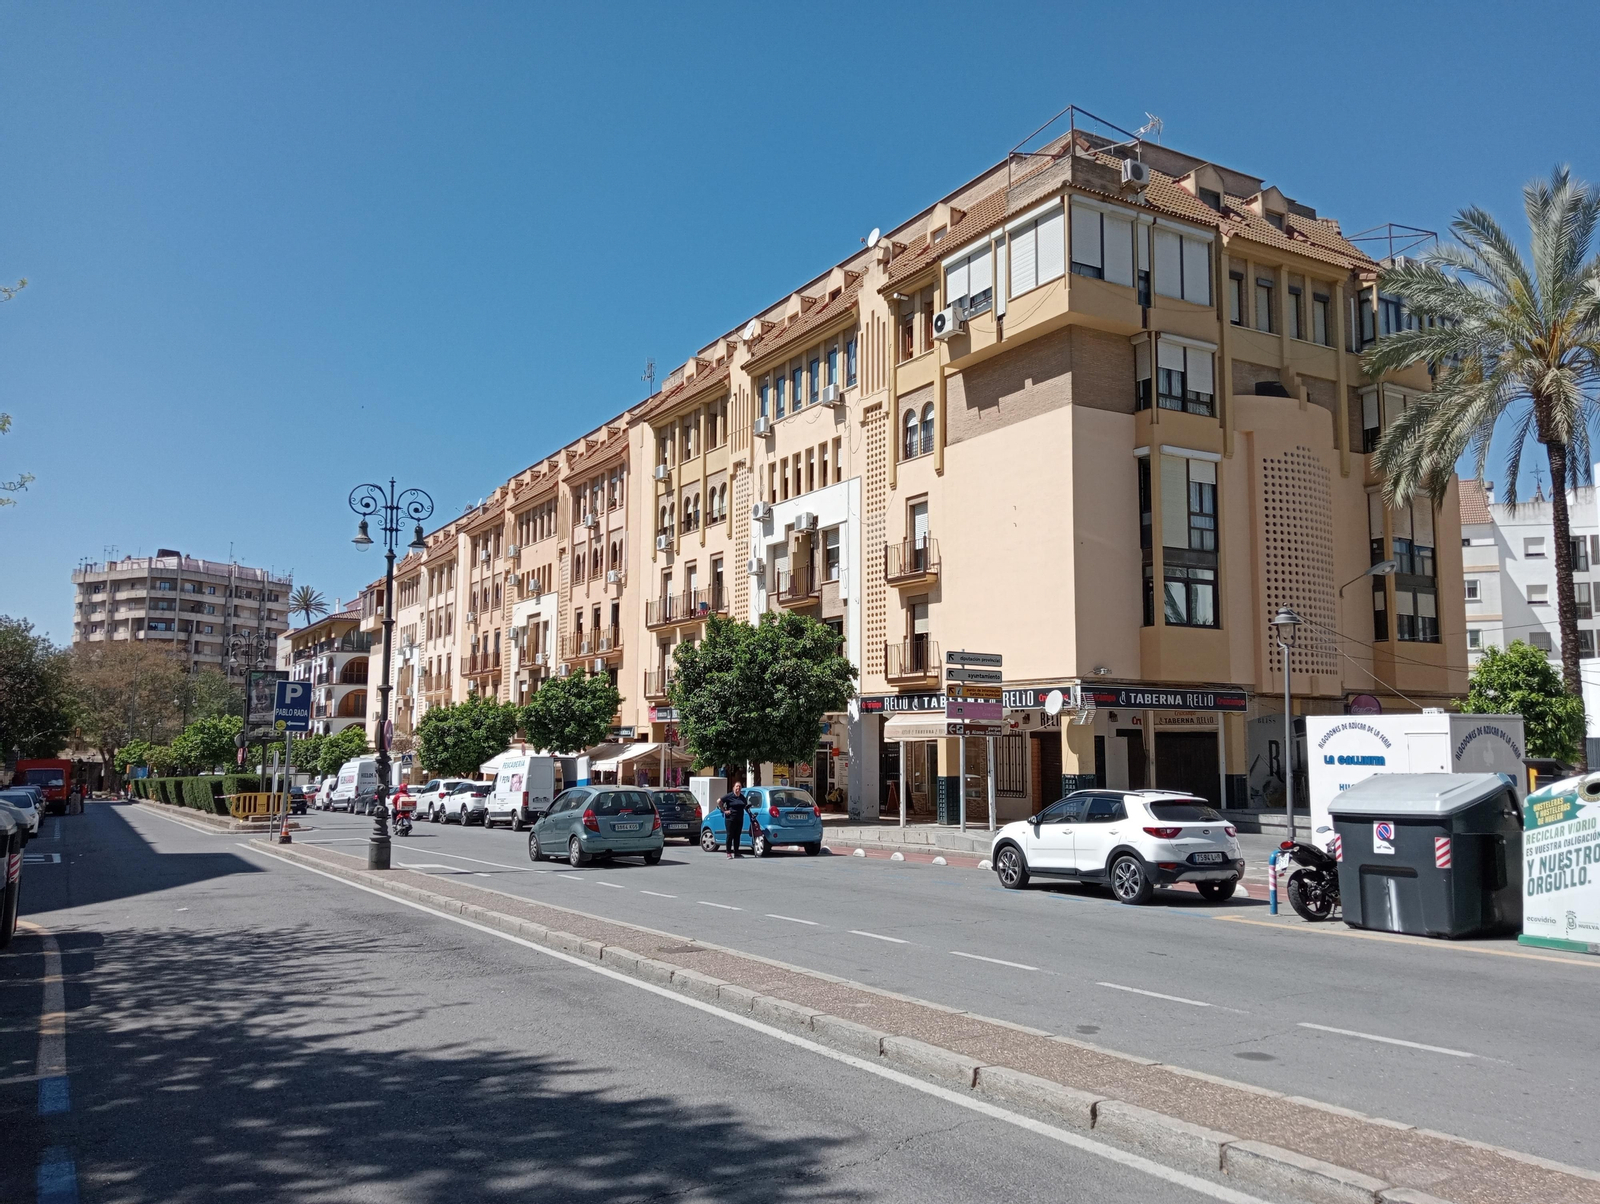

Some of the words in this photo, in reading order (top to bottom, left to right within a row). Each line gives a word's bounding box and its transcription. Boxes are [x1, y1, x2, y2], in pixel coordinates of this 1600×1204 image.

[285, 683, 303, 704] P
[1129, 693, 1182, 705] TABERNA
[275, 708, 293, 717] PABLO
[1341, 723, 1348, 731] DE
[1373, 728, 1381, 738] LA
[1476, 726, 1483, 737] DE
[1505, 734, 1512, 746] LA
[1323, 754, 1336, 765] LA
[1337, 754, 1386, 767] GALLINITA
[1533, 797, 1564, 812] HOSTELERAS
[1540, 802, 1571, 817] HOSTELEROS
[1537, 817, 1544, 826] DE
[1544, 812, 1564, 824] HUELVA
[1526, 825, 1565, 846] RECICLAR
[1568, 817, 1597, 835] VIDRIO
[1526, 847, 1533, 857] ES
[1535, 840, 1562, 855] VUESTRA
[1526, 858, 1535, 878] Y
[1539, 843, 1600, 875] NUESTRO
[1527, 866, 1592, 897] ORGULLO.
[1526, 915, 1557, 924] ecovidrio
[1578, 923, 1600, 931] HUELVA
